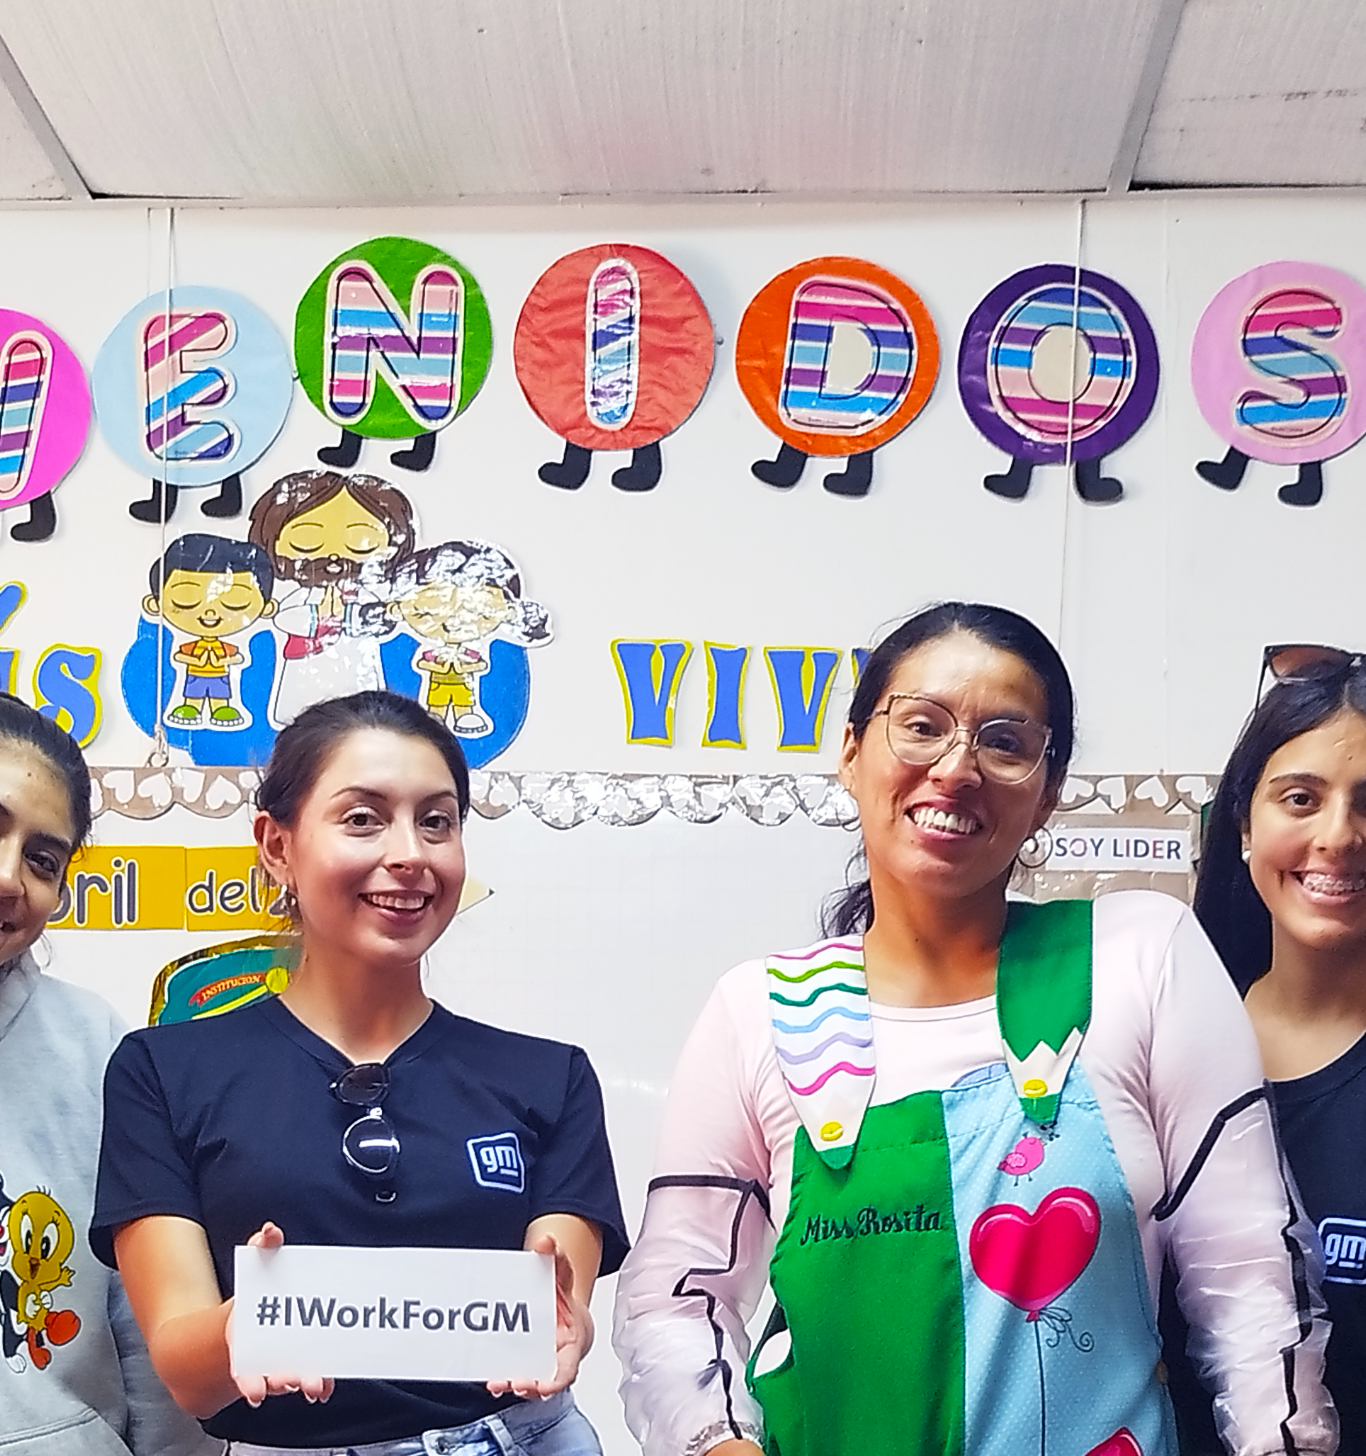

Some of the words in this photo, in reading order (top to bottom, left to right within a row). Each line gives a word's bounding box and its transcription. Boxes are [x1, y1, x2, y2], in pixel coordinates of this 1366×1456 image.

[611, 637, 875, 753] VIV
[1054, 837, 1105, 858] SOY
[1112, 838, 1182, 860] LIDER
[187, 870, 261, 916] del
[201, 974, 262, 1001] INSTITUCION
[480, 1145, 519, 1177] gm
[800, 1213, 855, 1246] Miss
[856, 1204, 944, 1236] Rosita
[256, 1295, 531, 1333] #IWorkForGM
